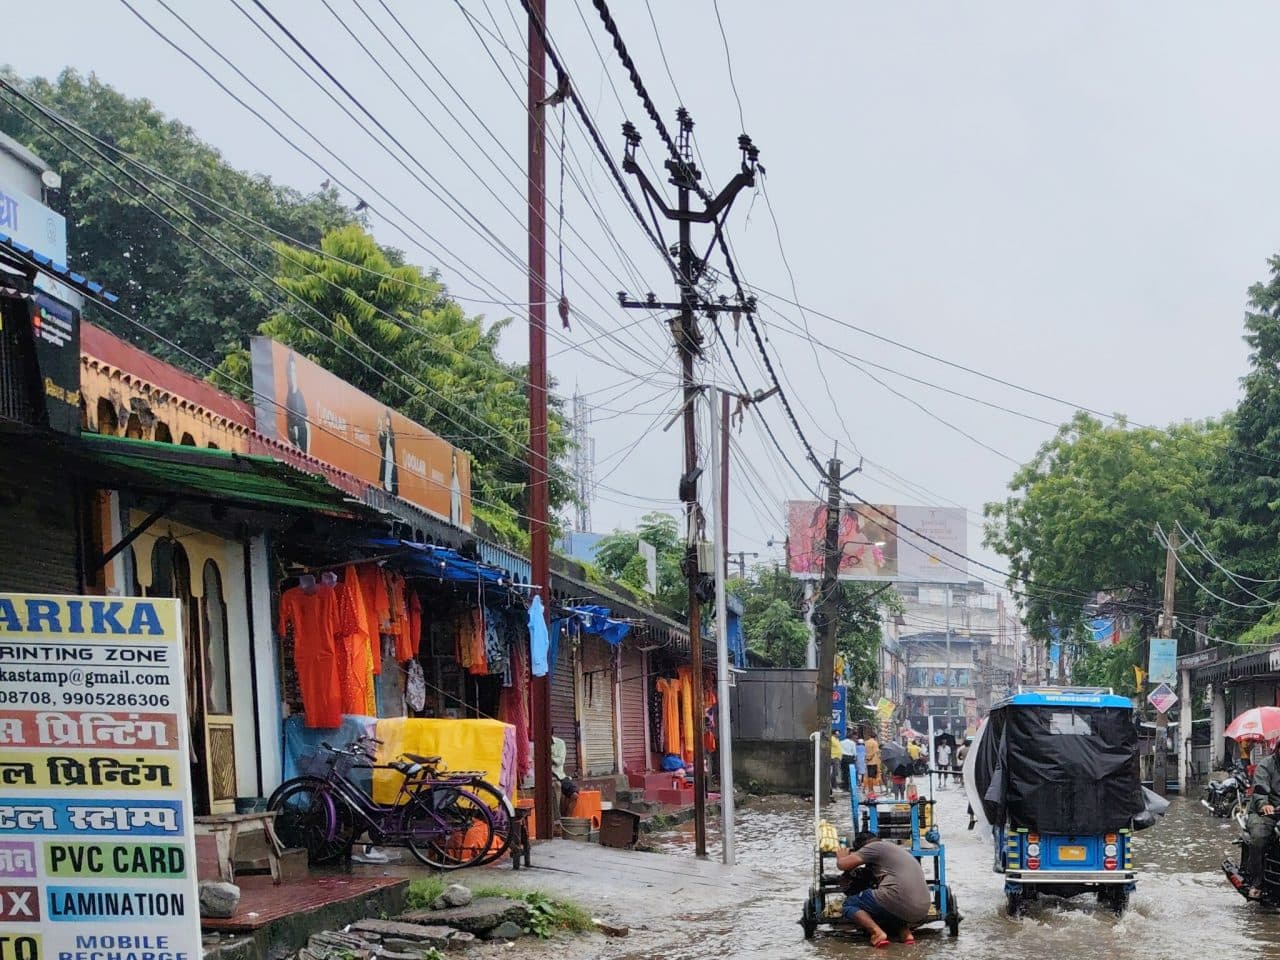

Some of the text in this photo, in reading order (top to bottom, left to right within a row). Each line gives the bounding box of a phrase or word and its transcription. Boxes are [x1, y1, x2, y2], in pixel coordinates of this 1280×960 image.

[105, 649, 167, 662] ZONE
[62, 691, 170, 707] 9905286306
[36, 712, 169, 746] प्रिन्टिंग
[47, 756, 173, 787] प्रिन्टिंग
[66, 806, 178, 831] स्टाम्प
[50, 846, 185, 874] PVC CARD
[0, 891, 33, 917] X
[51, 892, 185, 916] LAMINATION
[75, 935, 169, 950] MOBILE
